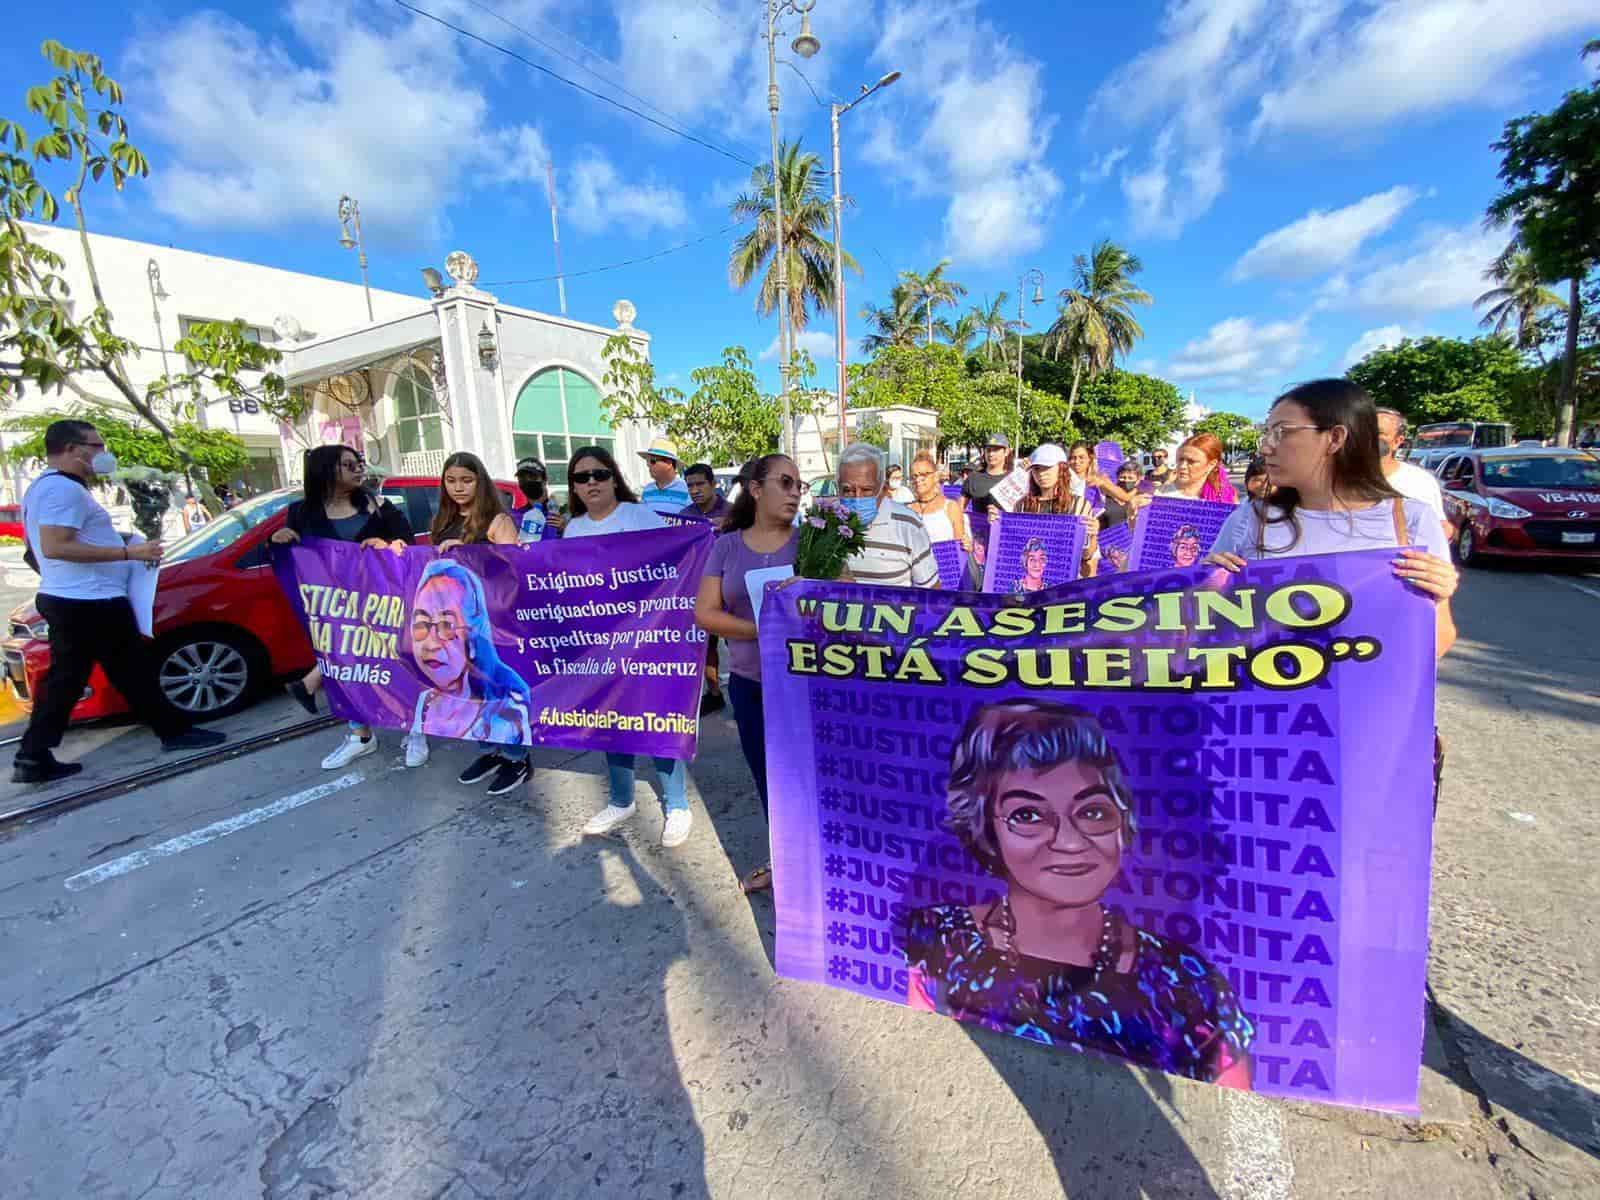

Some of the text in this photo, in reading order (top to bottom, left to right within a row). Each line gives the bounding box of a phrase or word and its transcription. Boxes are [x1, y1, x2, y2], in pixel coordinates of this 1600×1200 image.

[527, 562, 679, 593] Exigimos justicia
[516, 595, 696, 623] averiguaciones prontas
[933, 583, 1346, 637] ASESINO
[518, 624, 706, 654] y expeditas por parte de
[534, 660, 552, 675] la
[600, 657, 616, 675] de
[621, 658, 697, 676] Veracruz
[789, 638, 943, 682] ESTÁ
[540, 707, 696, 734] #JusticiaParaToñita
